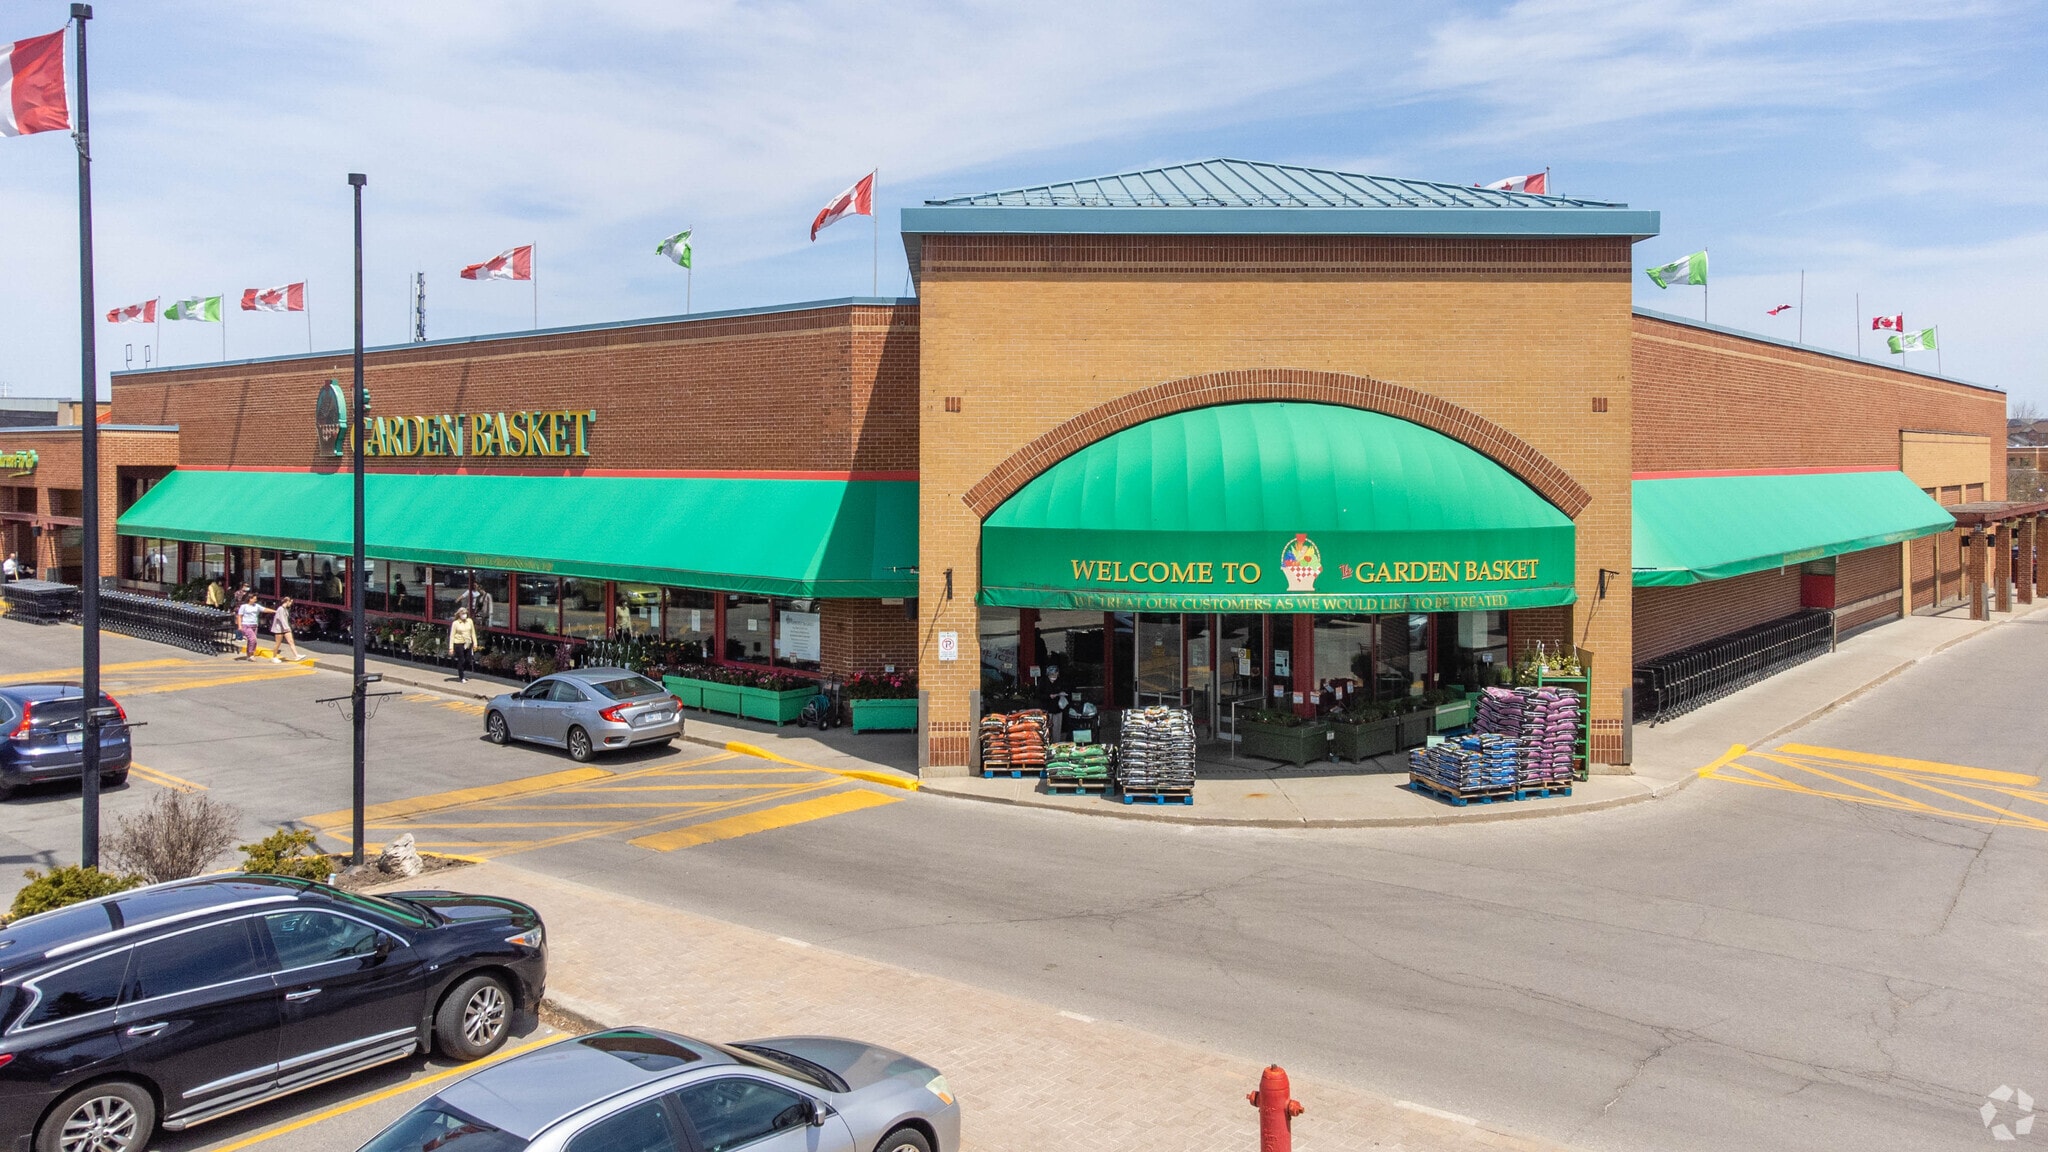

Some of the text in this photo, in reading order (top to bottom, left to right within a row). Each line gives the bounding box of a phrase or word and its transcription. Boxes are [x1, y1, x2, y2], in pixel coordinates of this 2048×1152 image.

[471, 410, 596, 456] BASKET
[1071, 559, 1262, 584] WELCOME TO
[1355, 561, 1461, 583] GARDEN
[1464, 558, 1539, 582] BASKET
[1097, 596, 1144, 610] TREAT
[1145, 597, 1178, 610] OUR
[1181, 598, 1272, 611] CUSTOMERS
[1275, 598, 1294, 611] AS
[1296, 598, 1320, 611] WE
[1322, 598, 1378, 611] WOULD
[1415, 597, 1433, 610] TO
[1453, 593, 1508, 609] TREATED
